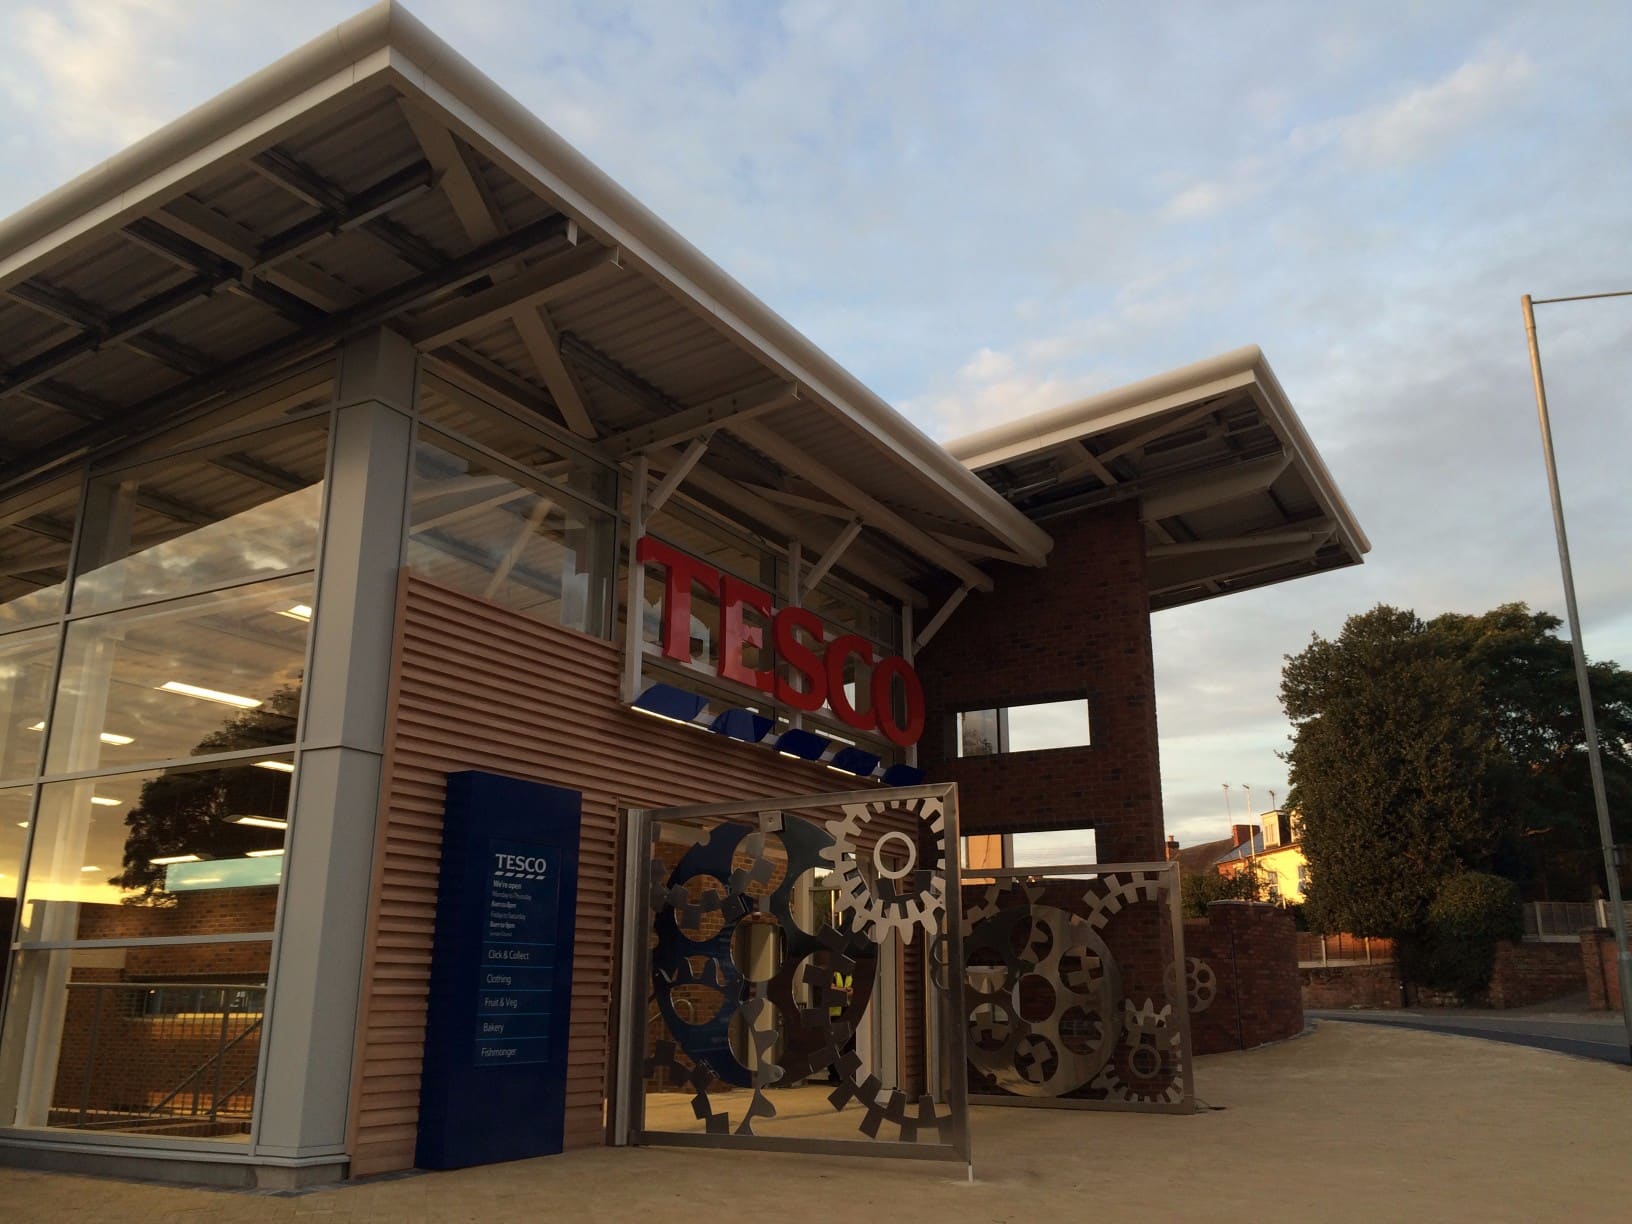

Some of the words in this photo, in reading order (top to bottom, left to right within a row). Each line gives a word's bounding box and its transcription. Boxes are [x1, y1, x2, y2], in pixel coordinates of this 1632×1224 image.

[637, 535, 926, 747] TESCO
[495, 853, 547, 873] TESCO
[488, 949, 502, 959] Click
[502, 950, 509, 960] &
[509, 950, 530, 960] Collect
[486, 974, 512, 985] Clothing
[484, 997, 499, 1007] Fruit
[506, 998, 518, 1008] Veg
[483, 1022, 505, 1034] Bakery
[481, 1047, 518, 1058] Fishmonger
